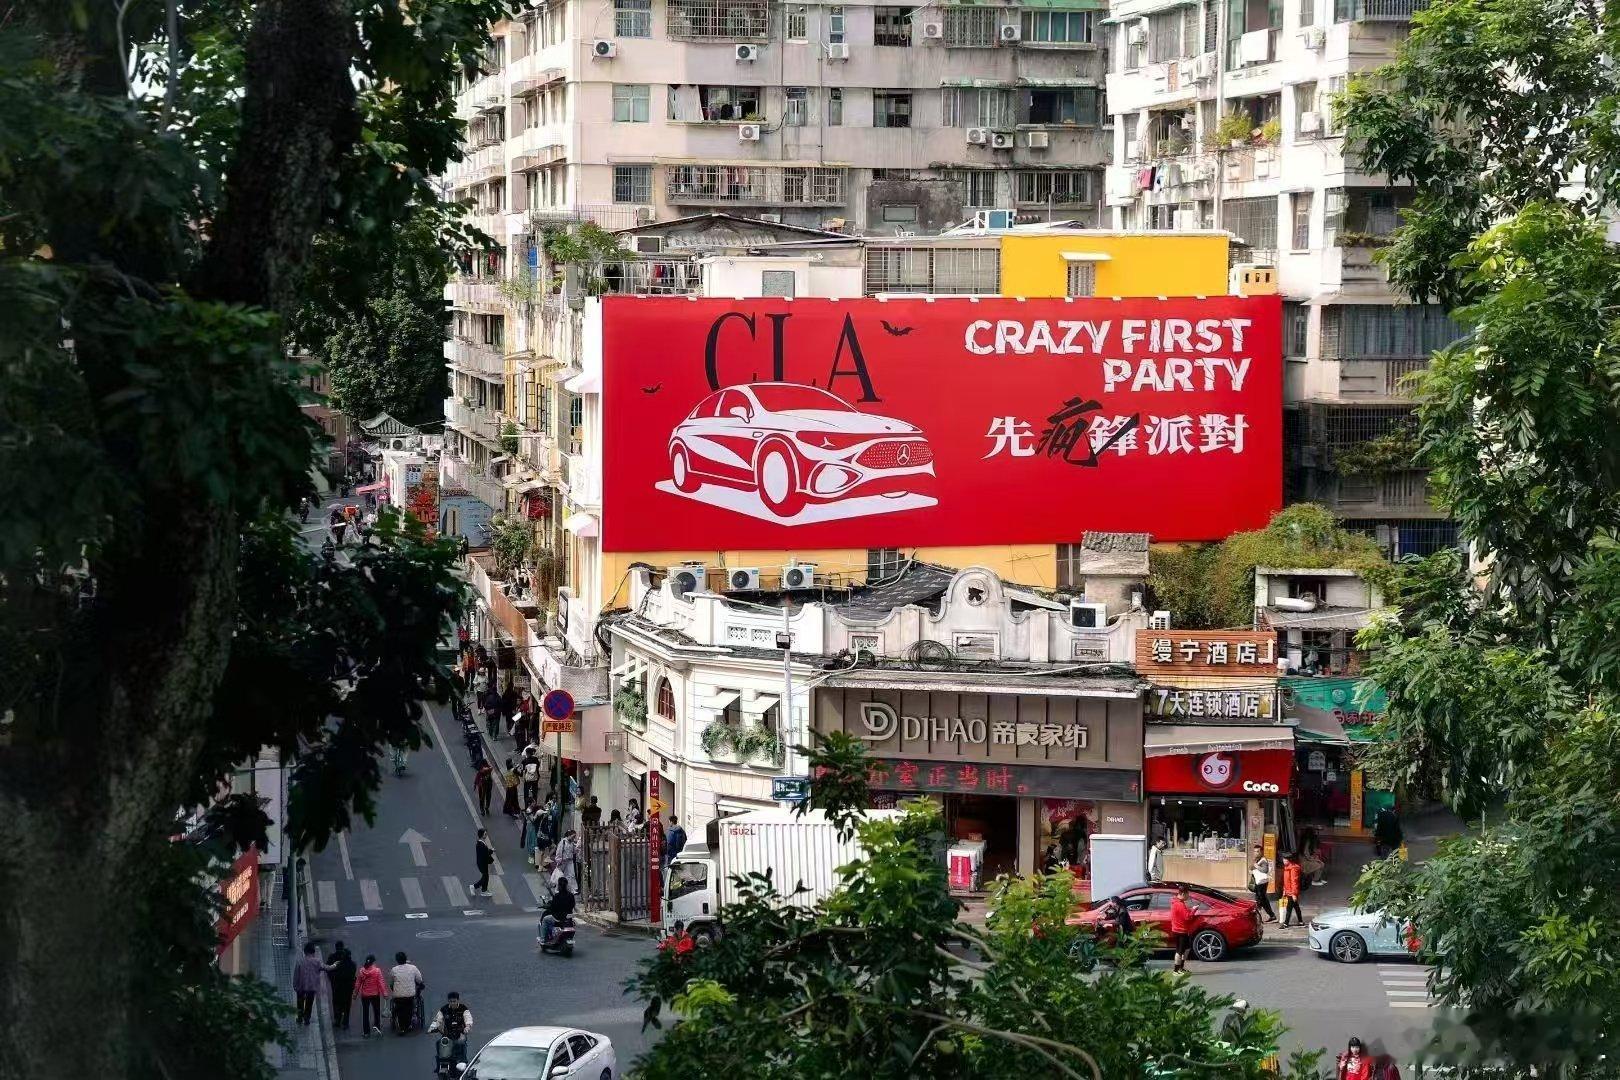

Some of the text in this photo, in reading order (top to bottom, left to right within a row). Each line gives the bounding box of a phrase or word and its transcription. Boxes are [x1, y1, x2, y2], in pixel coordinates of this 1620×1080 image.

[964, 318, 1251, 355] CRAZY FIRST
[704, 311, 884, 403] CLA
[1103, 357, 1252, 393] PARTY
[1151, 638, 1257, 665] 缦宁酒店
[1157, 689, 1259, 718] 7天连锁酒店
[901, 716, 987, 744] DIHAO
